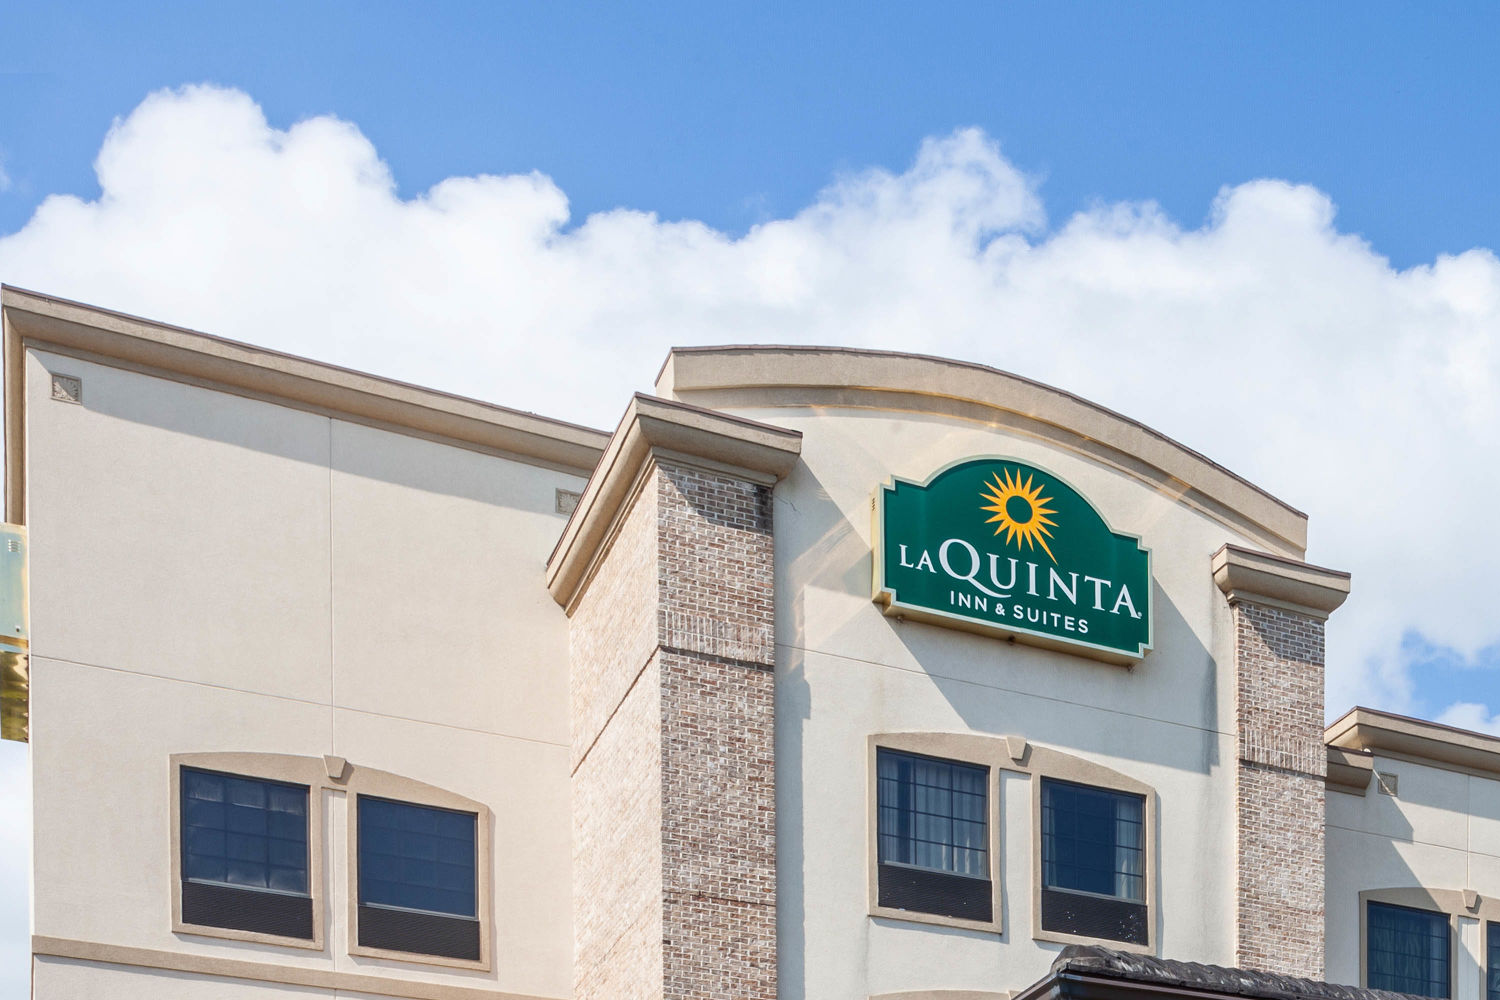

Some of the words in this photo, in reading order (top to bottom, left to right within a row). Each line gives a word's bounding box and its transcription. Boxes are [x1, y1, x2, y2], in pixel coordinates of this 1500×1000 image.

[899, 544, 937, 574] LA
[938, 538, 1141, 619] QUINTA
[950, 590, 988, 612] INN
[995, 603, 1006, 616] &
[1013, 604, 1089, 634] SUITES
